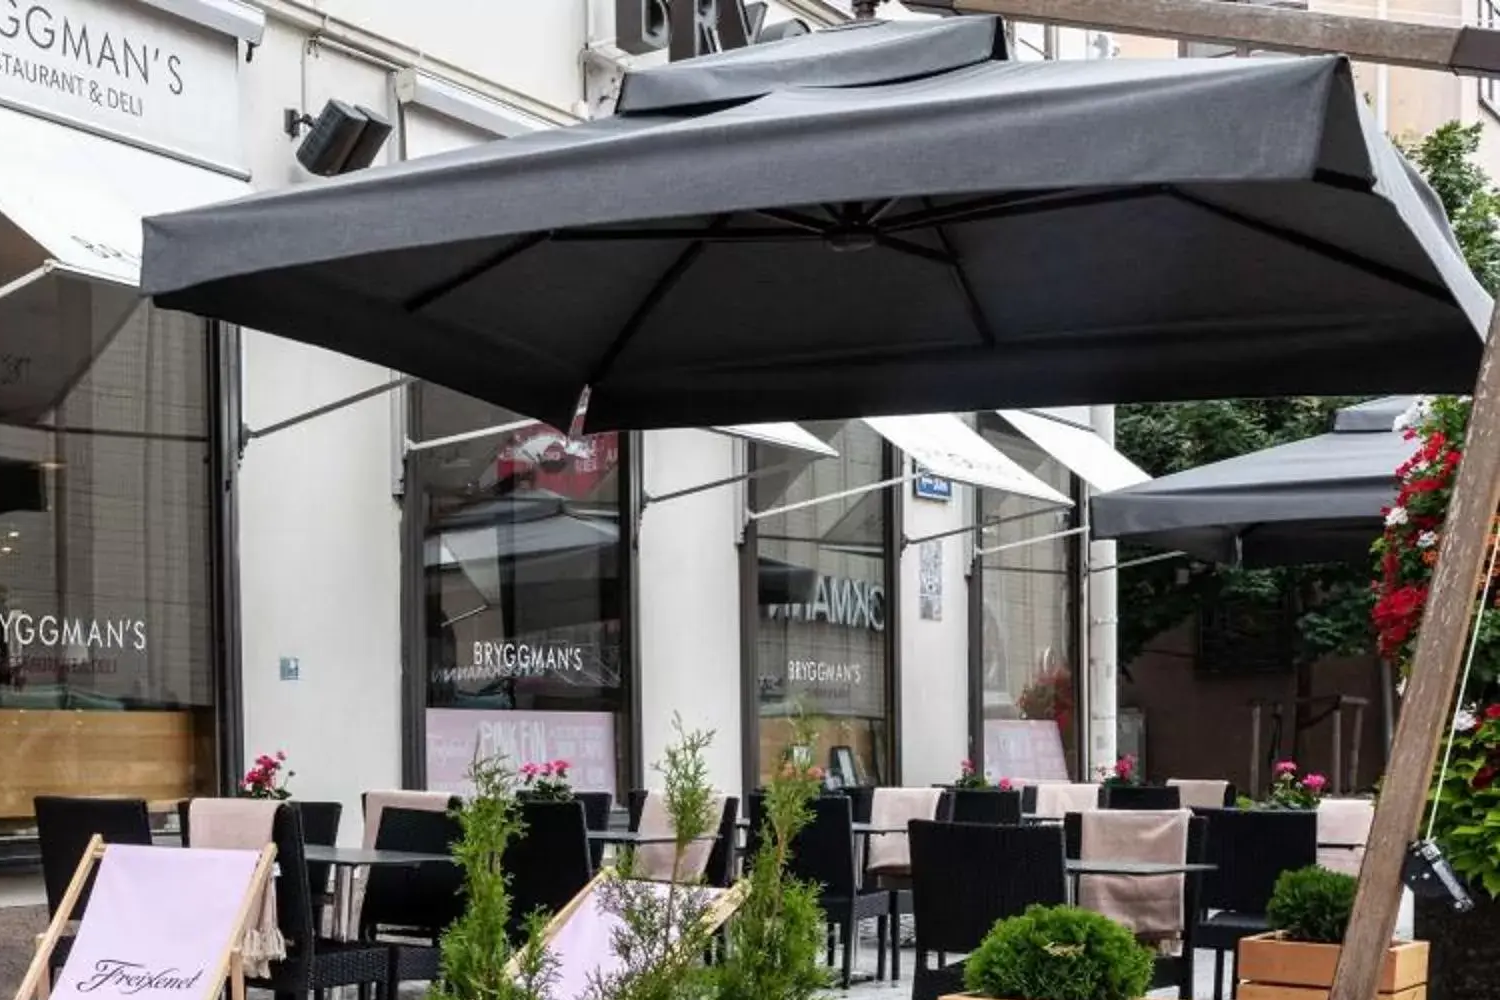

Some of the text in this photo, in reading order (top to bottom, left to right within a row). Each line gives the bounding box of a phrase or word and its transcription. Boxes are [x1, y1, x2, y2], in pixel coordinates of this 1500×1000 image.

[88, 79, 103, 107] &
[107, 87, 144, 118] DELI
[473, 640, 584, 671] BRYGGMAN'S
[787, 660, 862, 684] BRYGGMAN'S
[74, 958, 204, 995] Freixenet
